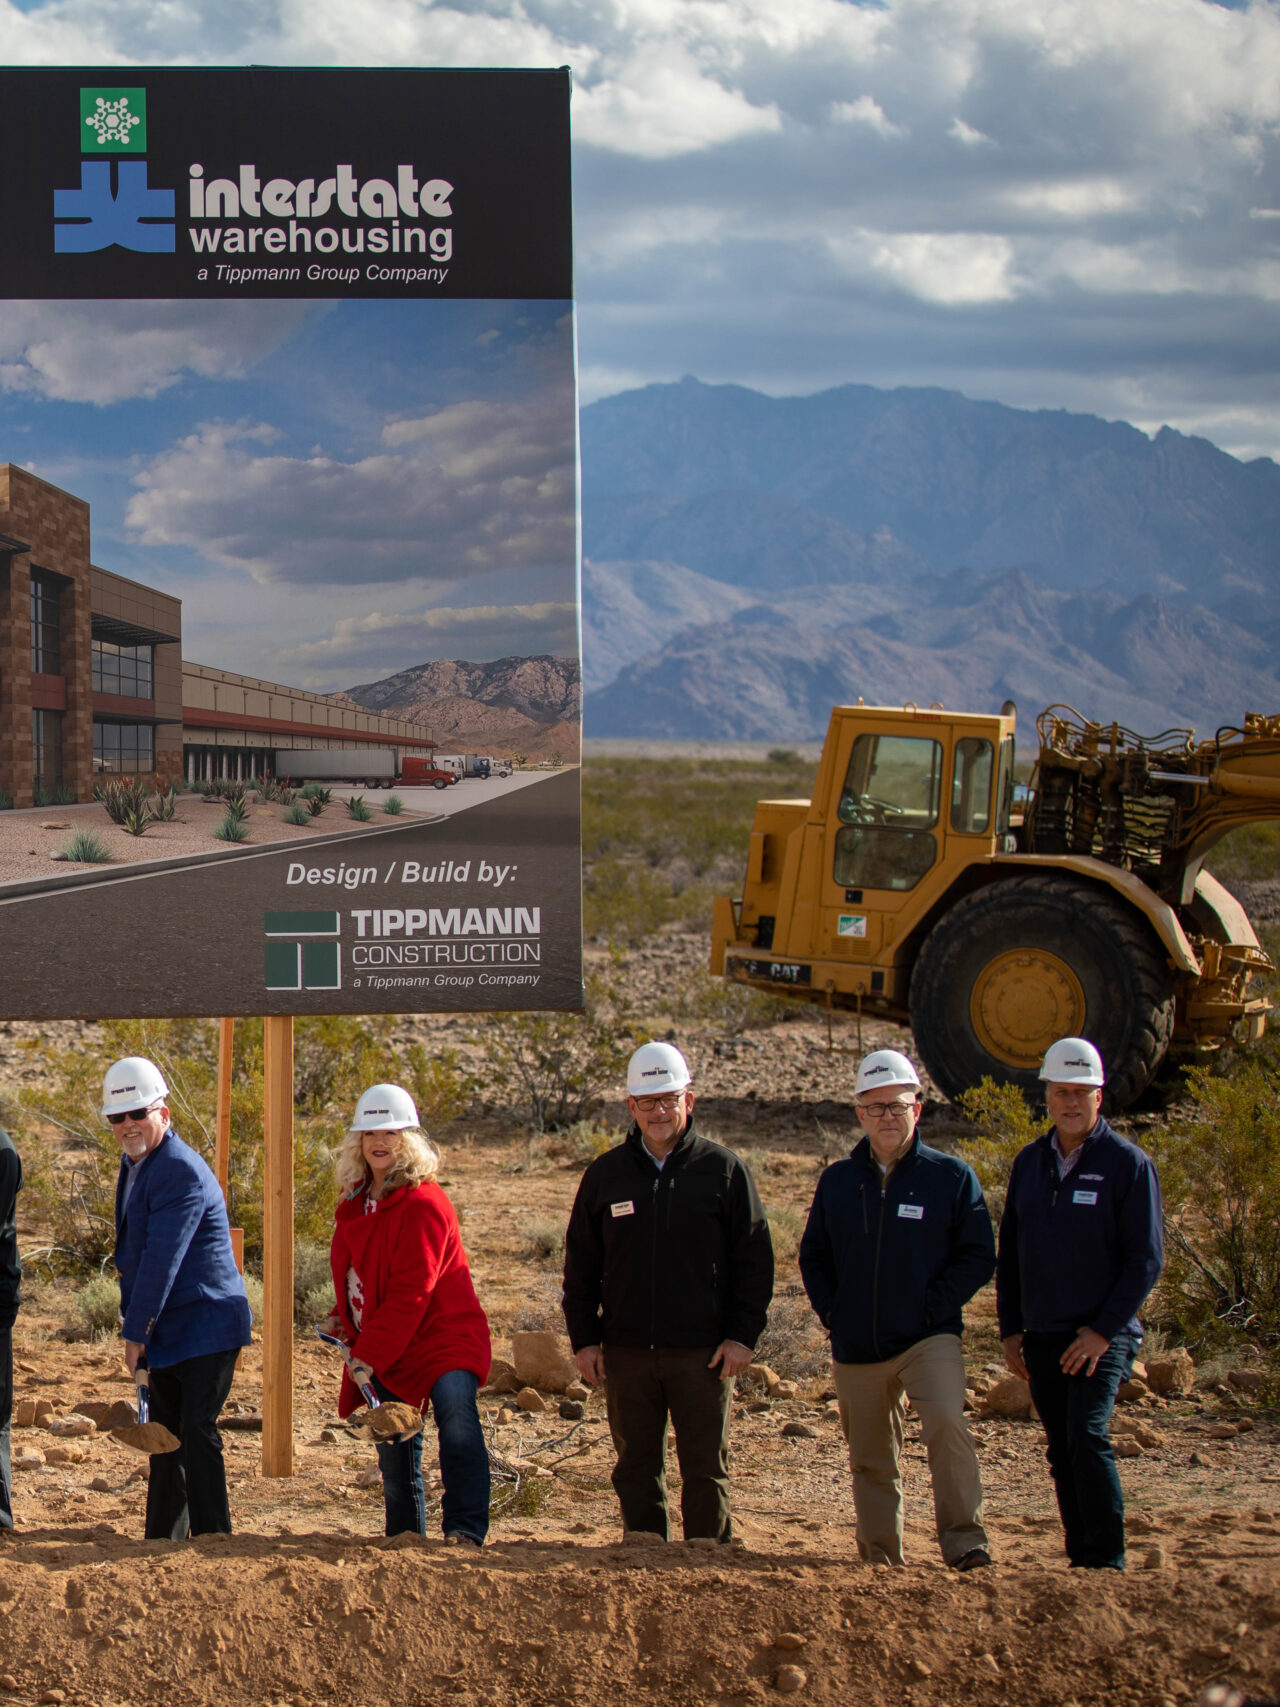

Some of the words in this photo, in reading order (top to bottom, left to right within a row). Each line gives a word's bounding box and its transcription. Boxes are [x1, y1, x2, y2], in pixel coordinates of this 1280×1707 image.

[188, 163, 455, 218] interstate
[188, 219, 454, 262] warehousing
[197, 268, 208, 281] a
[215, 264, 301, 285] Tippmann
[306, 264, 360, 284] Group
[366, 264, 449, 285] Company
[286, 862, 378, 890] Design
[383, 861, 397, 884] /
[401, 860, 472, 883] Build
[476, 860, 518, 888] by:
[350, 906, 541, 937] TIPPMANN
[352, 943, 541, 965] CONSTRUCTION
[353, 978, 362, 988] a
[366, 975, 430, 990] Tippmann
[434, 974, 474, 988] Group
[478, 973, 541, 987] Company
[771, 964, 801, 983] CAT
